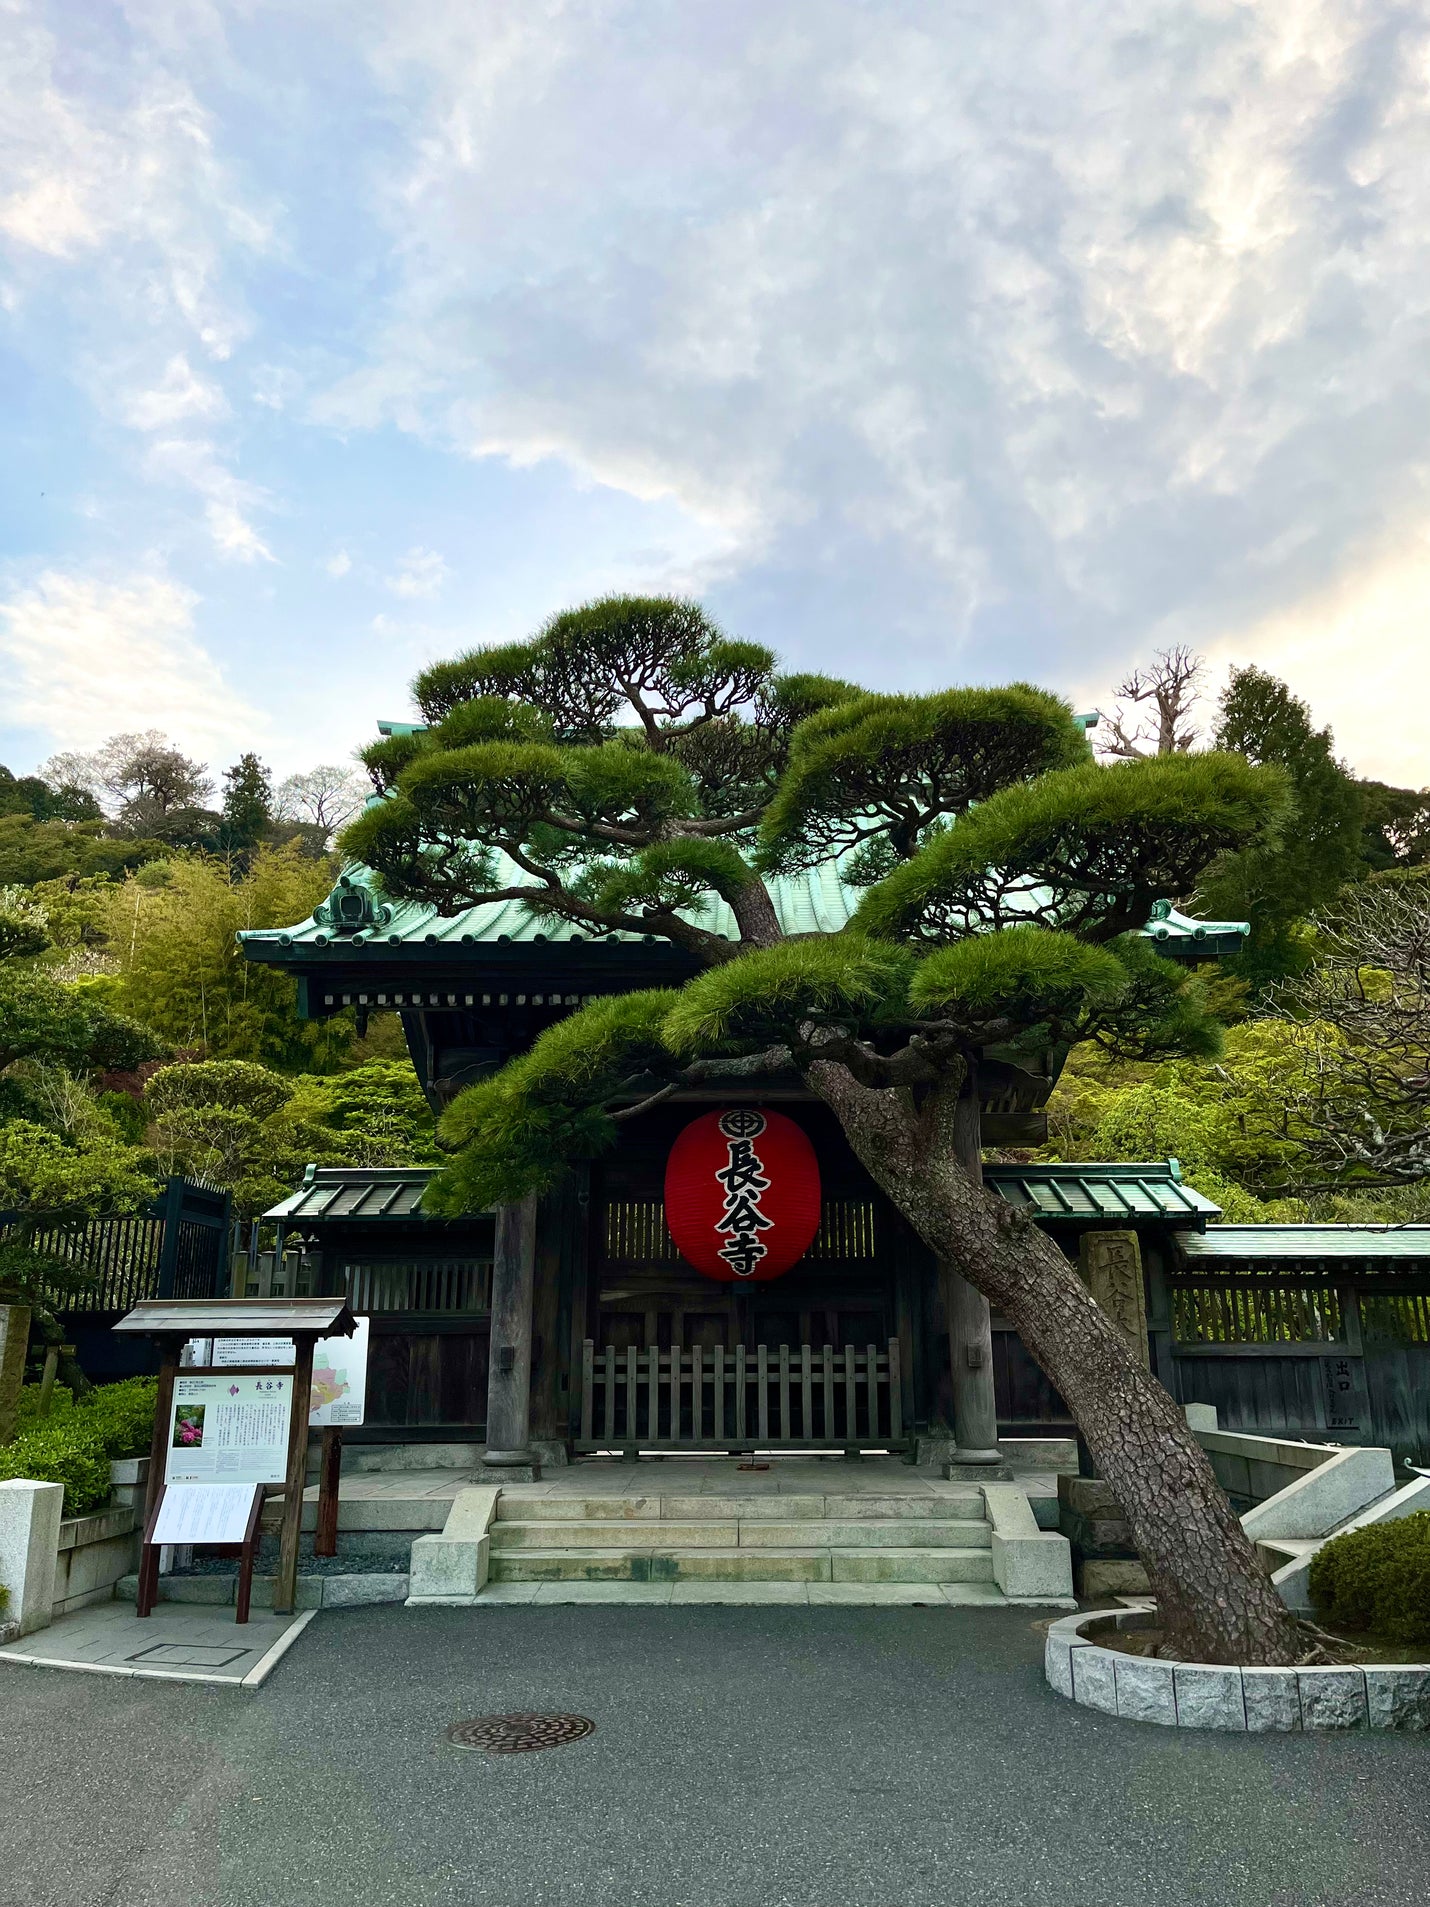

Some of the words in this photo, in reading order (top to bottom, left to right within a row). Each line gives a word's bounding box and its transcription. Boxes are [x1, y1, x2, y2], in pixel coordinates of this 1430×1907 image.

[715, 1138, 775, 1275] 長谷寺
[1336, 1360, 1350, 1391] 出口
[255, 1381, 284, 1391] 長谷寺
[1331, 1417, 1354, 1425] EXIT
